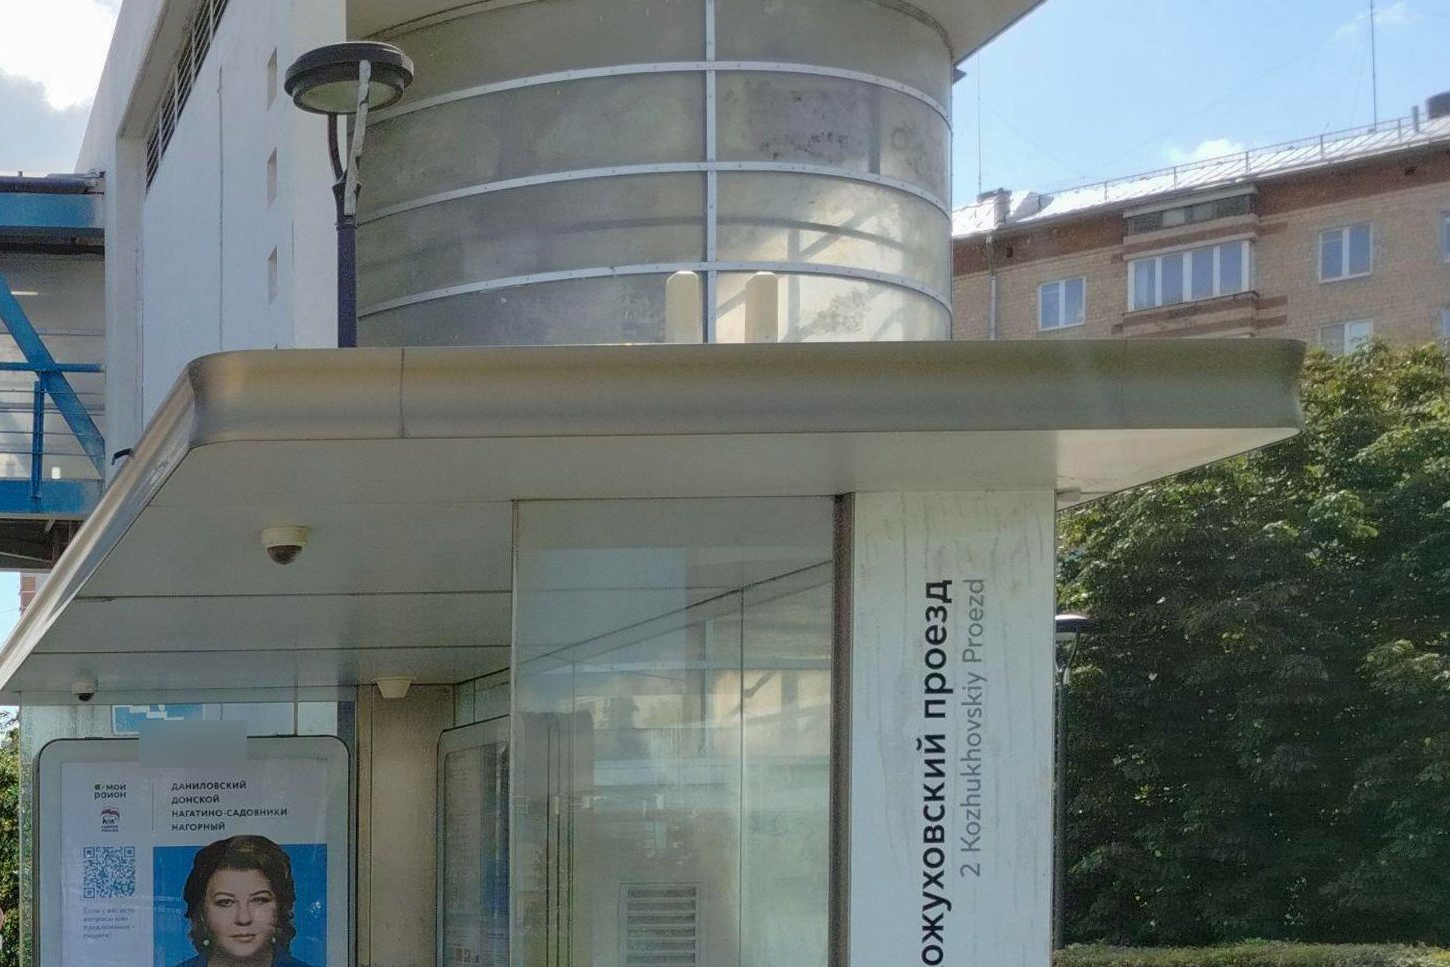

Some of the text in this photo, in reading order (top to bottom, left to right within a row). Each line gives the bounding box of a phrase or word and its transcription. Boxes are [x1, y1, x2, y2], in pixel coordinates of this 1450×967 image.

[922, 579, 954, 719] проезд
[960, 578, 988, 878] 2 Kozhukhovskiy Proezd
[106, 782, 126, 790] мой
[171, 780, 247, 792] ДАНИЛОВСКИЙ
[171, 794, 220, 805] ДОНСКОЙ
[171, 808, 287, 818] НАГАТИНО-САДОВНИКИ
[171, 821, 225, 832] НАГОРНЫЙ
